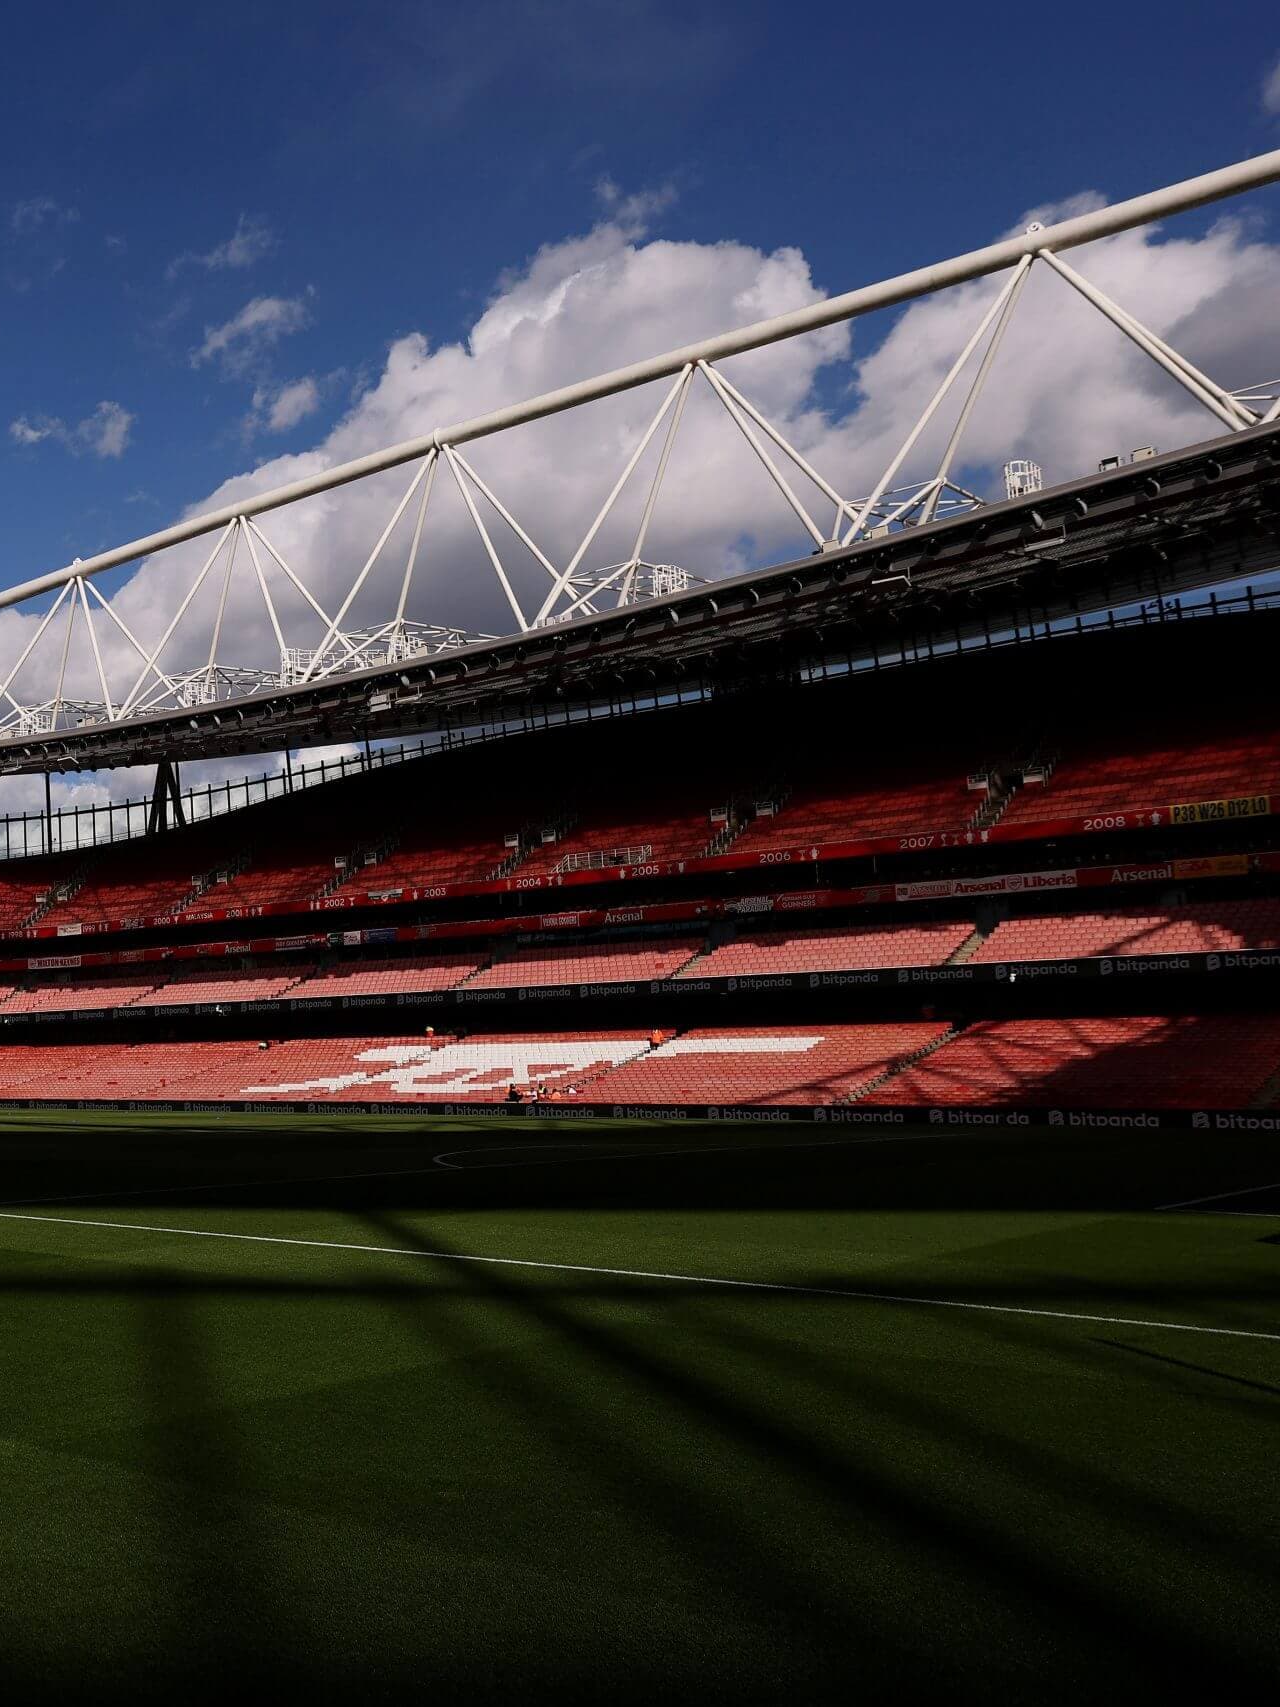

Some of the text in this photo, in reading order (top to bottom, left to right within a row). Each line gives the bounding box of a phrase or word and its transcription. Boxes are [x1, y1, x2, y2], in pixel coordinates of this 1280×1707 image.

[1174, 805, 1195, 823] P38
[1198, 801, 1224, 819] W26
[1228, 799, 1248, 816] D12
[1083, 816, 1126, 831] 2008
[899, 836, 935, 849] 2007
[760, 852, 791, 864] 2006
[631, 865, 660, 876] 2005
[1112, 864, 1173, 883] Arsenal
[516, 878, 541, 889] 2004
[954, 873, 1078, 894] Arsenal Liberia
[424, 888, 447, 898] 2003
[324, 899, 345, 908] 2002
[226, 910, 243, 918] 2001
[604, 910, 643, 923] Arsenal
[153, 917, 171, 925] 2000
[224, 944, 251, 954] Arsenal
[1117, 958, 1190, 972] bitpanda
[823, 972, 880, 986] bitpanda
[912, 969, 973, 983] bitpanda
[662, 981, 711, 994] bitpanda
[740, 977, 792, 990] bitpanda
[465, 991, 506, 1002] bitpanda
[528, 988, 570, 999] bitpanda
[590, 985, 636, 997] bitpanda
[298, 1000, 332, 1010] bitpanda
[351, 998, 386, 1008] bitpanda
[405, 995, 444, 1005] bitpanda
[248, 1002, 280, 1013] bitpanda
[539, 1106, 595, 1118] bitpanda
[627, 1107, 688, 1119] bitpanda
[724, 1108, 790, 1120] bitpanda
[831, 1109, 904, 1123] bitpanda
[1070, 1112, 1160, 1128] bitpanda
